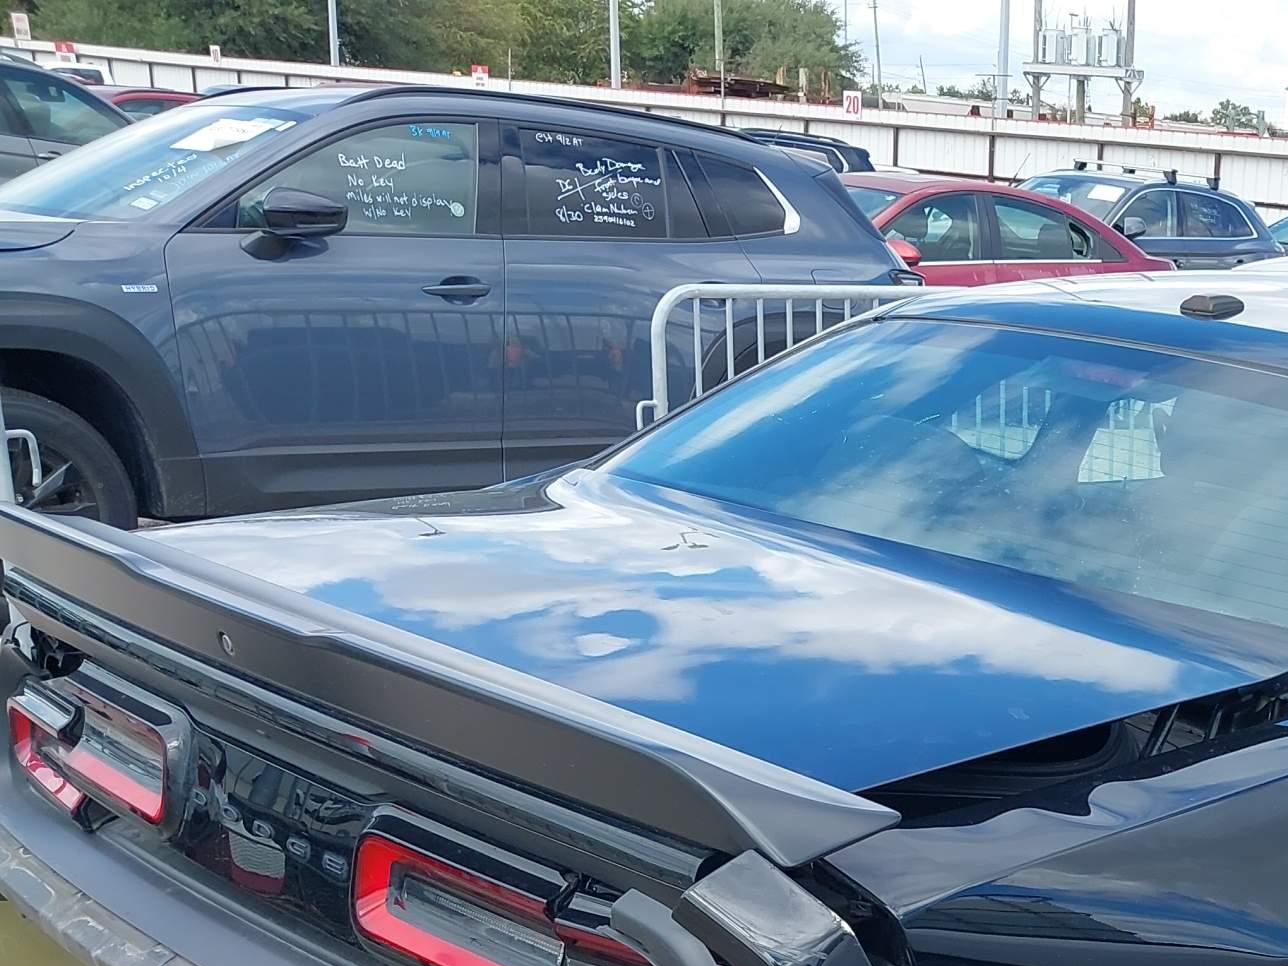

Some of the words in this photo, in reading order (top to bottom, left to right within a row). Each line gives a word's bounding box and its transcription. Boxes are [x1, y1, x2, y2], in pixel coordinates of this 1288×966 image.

[845, 95, 860, 114] 20
[337, 153, 369, 169] Batt
[373, 152, 406, 170] Dead
[347, 173, 364, 187] No
[371, 174, 394, 194] Key
[394, 195, 409, 205] not
[555, 206, 584, 224] 8/30
[191, 788, 349, 877] DODGE
